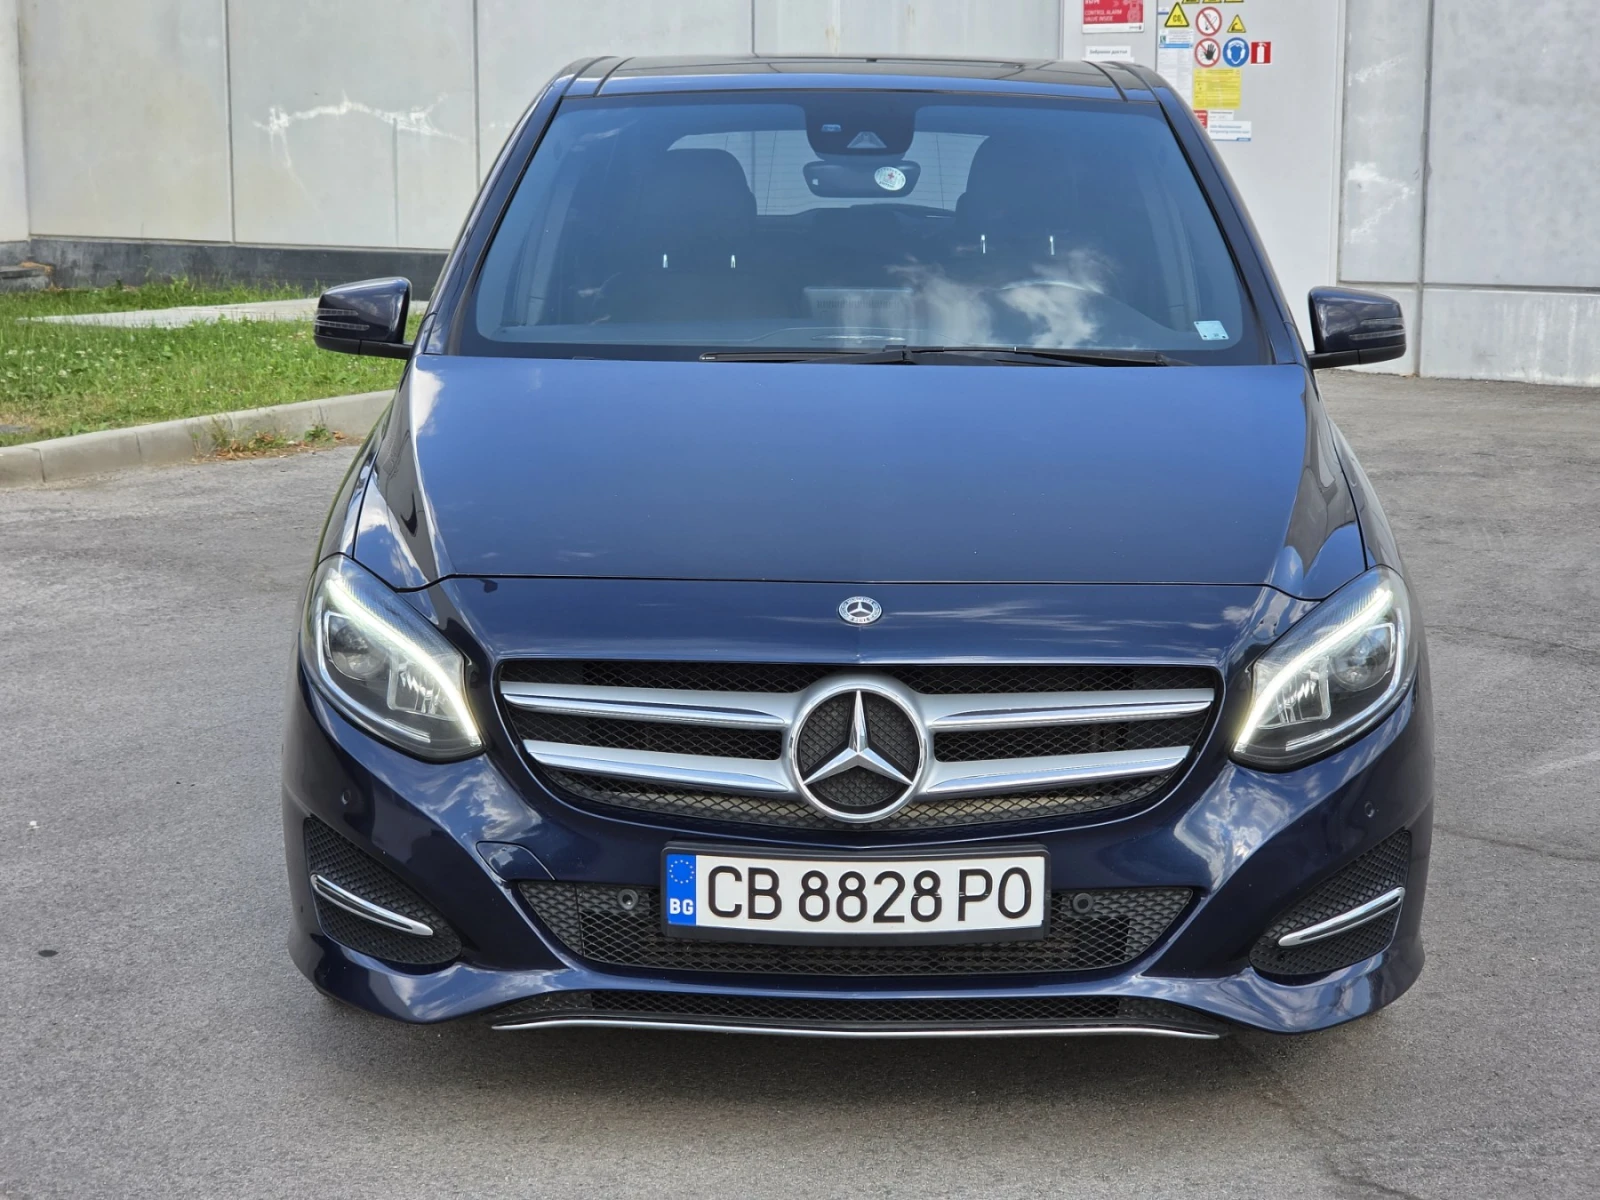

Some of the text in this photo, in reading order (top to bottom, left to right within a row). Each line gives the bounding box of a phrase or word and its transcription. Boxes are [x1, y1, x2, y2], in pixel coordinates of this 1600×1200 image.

[669, 898, 694, 915] BG
[707, 865, 782, 920] CB
[798, 870, 942, 923] 8828
